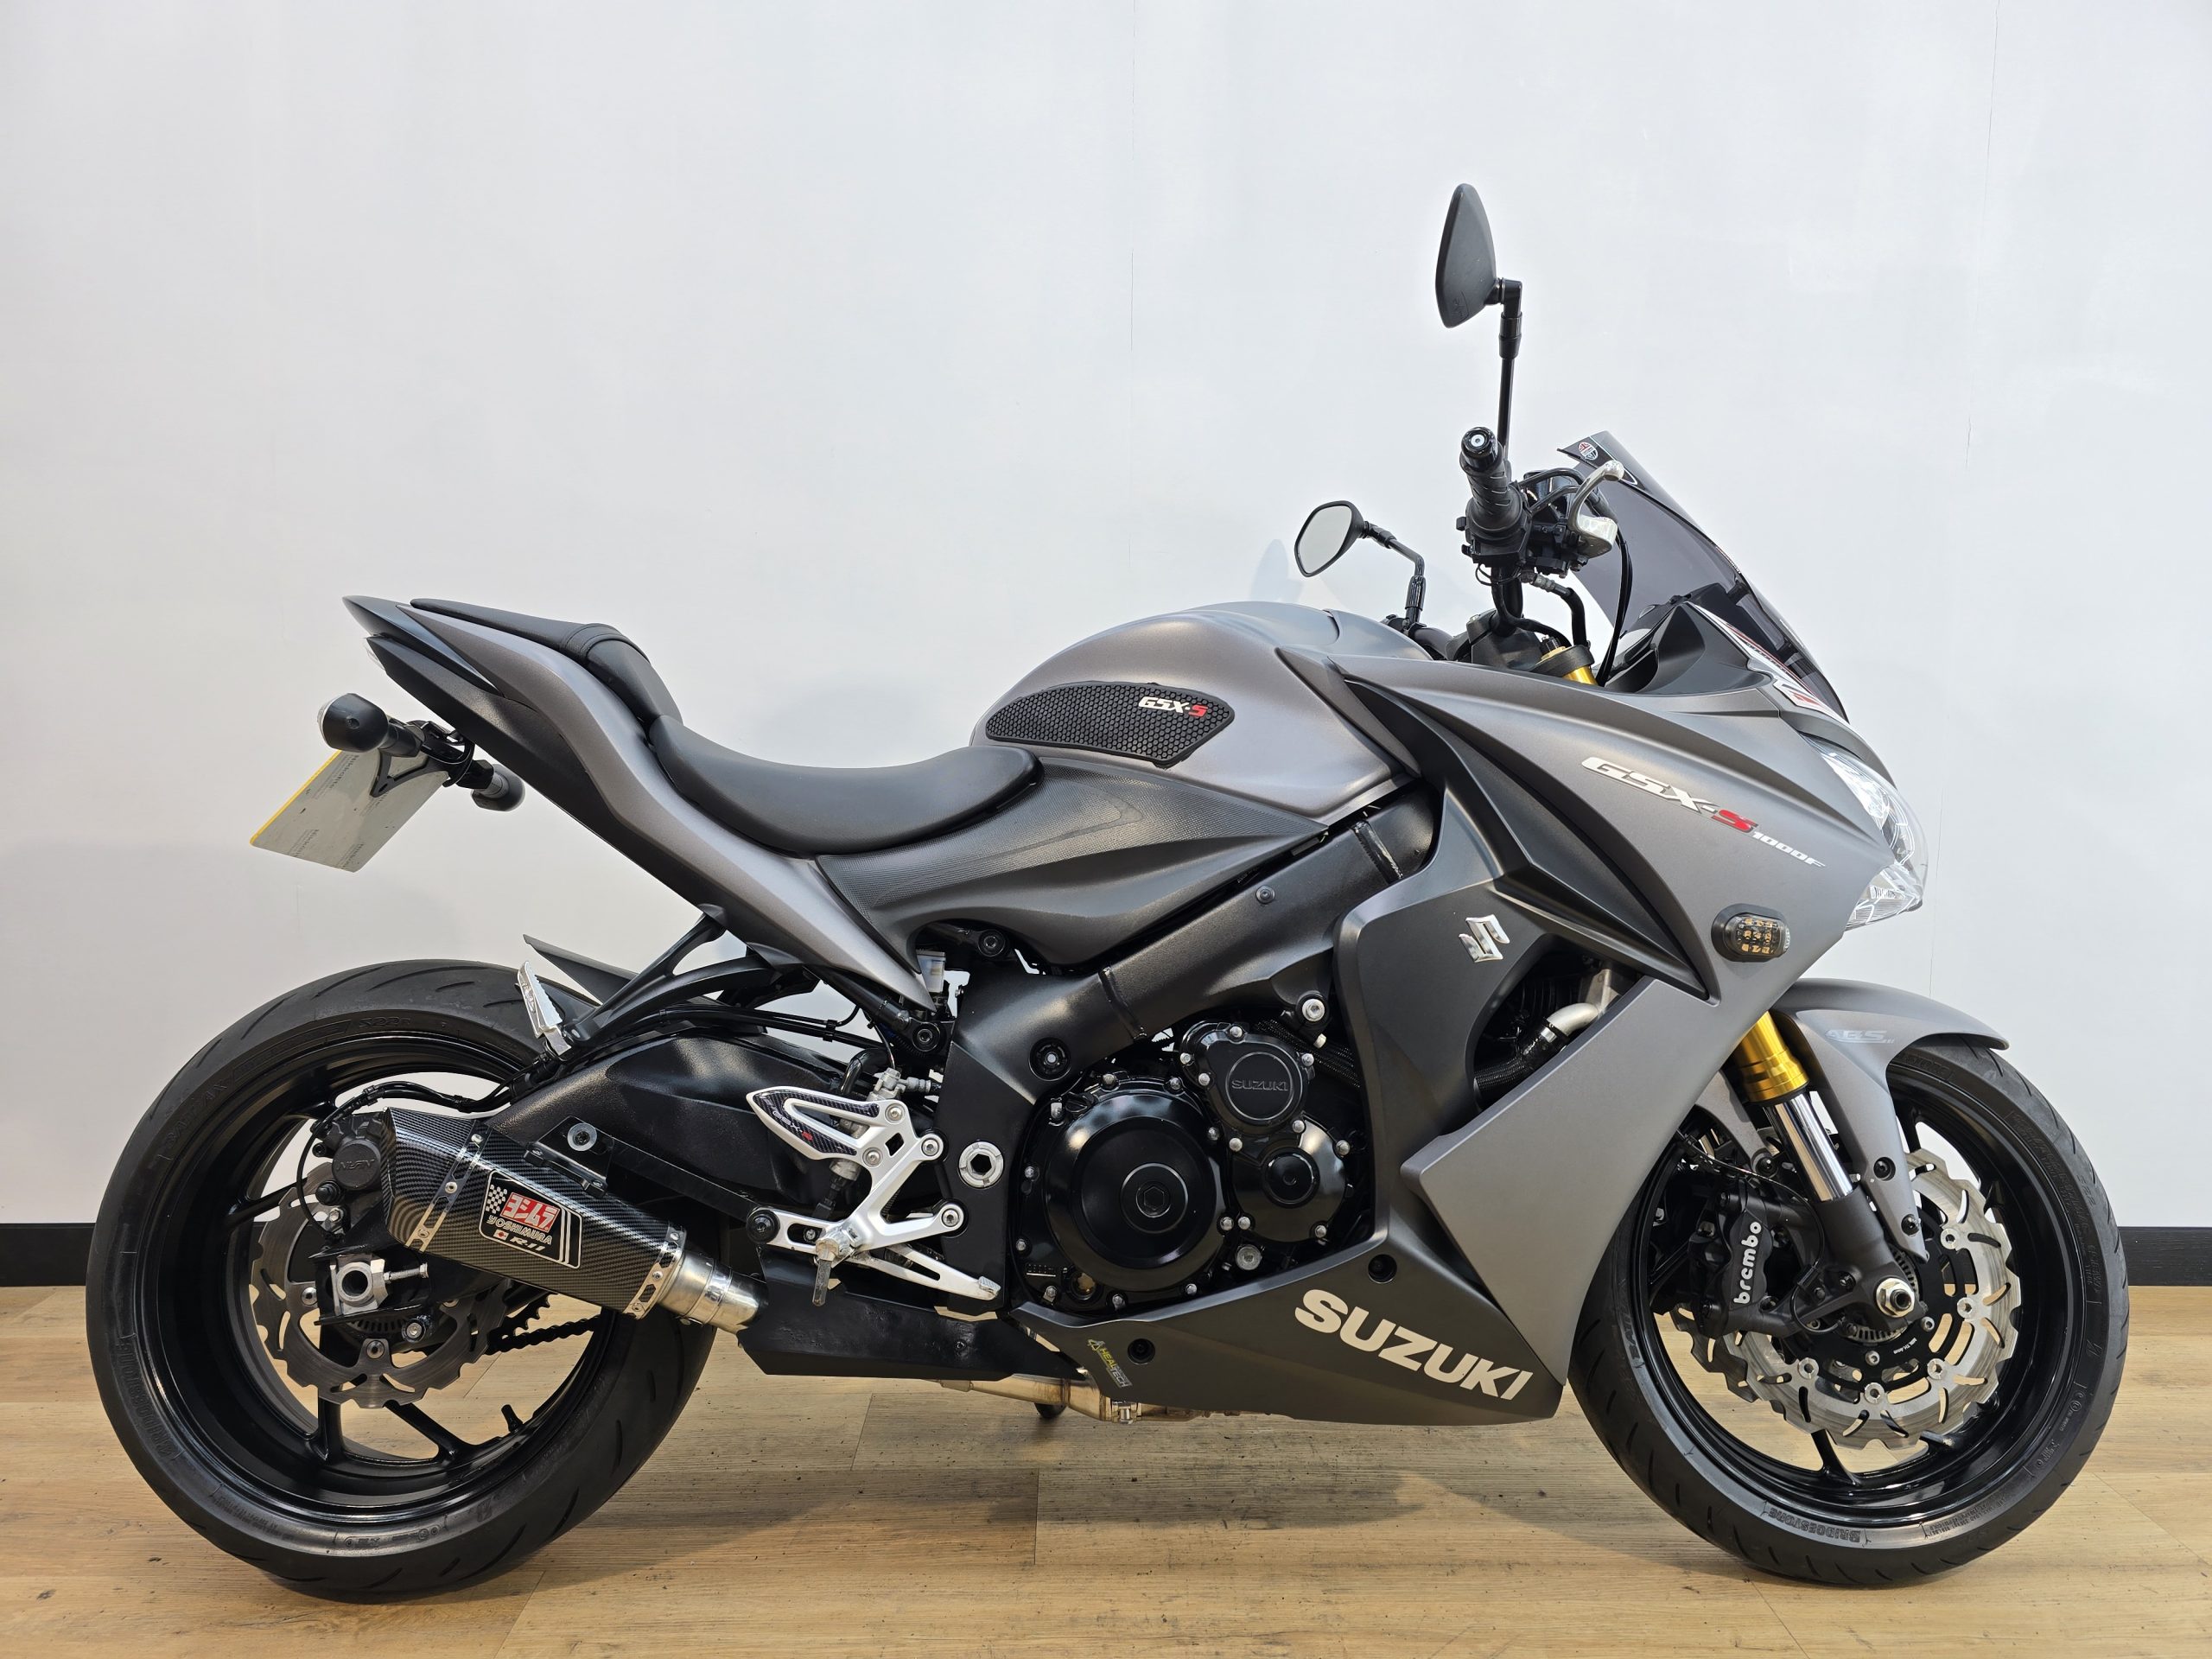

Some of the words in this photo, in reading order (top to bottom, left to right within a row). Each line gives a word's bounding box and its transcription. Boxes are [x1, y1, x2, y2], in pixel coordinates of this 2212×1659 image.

[1139, 696, 1208, 717] GSX-S
[1581, 757, 1758, 833] GSX-S
[1752, 831, 1826, 868] 1000F
[1825, 1029, 1888, 1044] ABS
[1231, 1079, 1288, 1091] SUZUKI
[486, 1215, 553, 1245] YOSHIMURA
[502, 1195, 556, 1230] ヨシムラ
[1733, 1222, 1762, 1304] brembo
[1294, 1289, 1534, 1401] SUZUKI
[1769, 1507, 1861, 1543] BRIDGESTONE
